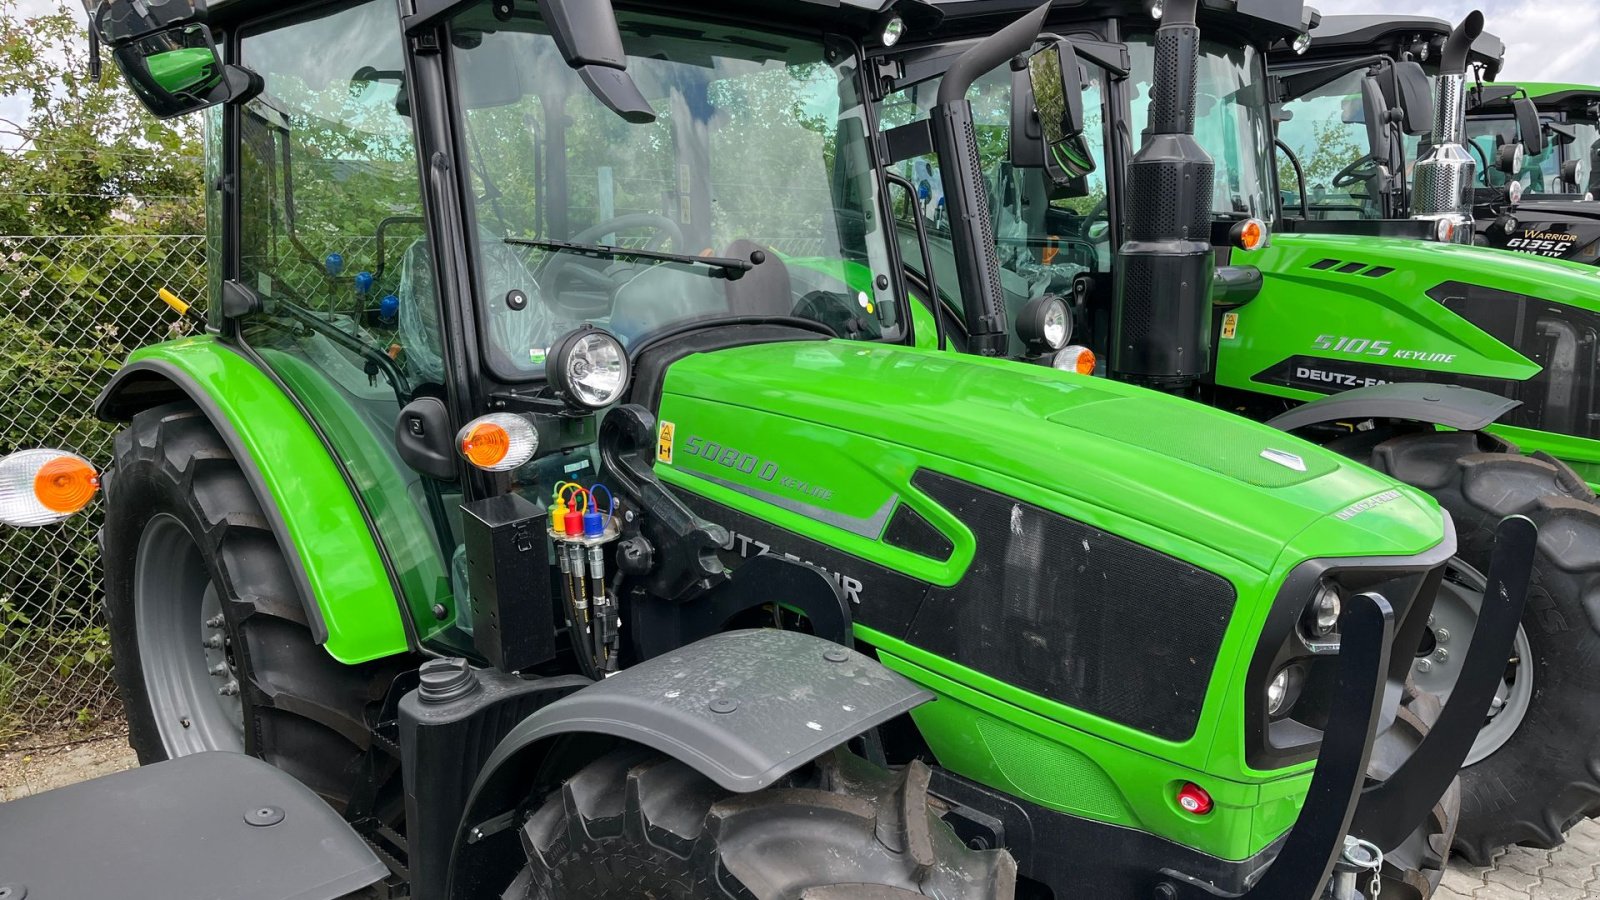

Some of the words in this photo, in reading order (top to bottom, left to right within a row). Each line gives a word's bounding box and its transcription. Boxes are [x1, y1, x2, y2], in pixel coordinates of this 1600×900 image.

[1311, 334, 1393, 356] 5105
[1393, 349, 1457, 364] KEYLINE
[1296, 367, 1394, 388] DEUTZ-FA
[682, 434, 759, 475] 5080
[781, 475, 833, 501] KEYLINE
